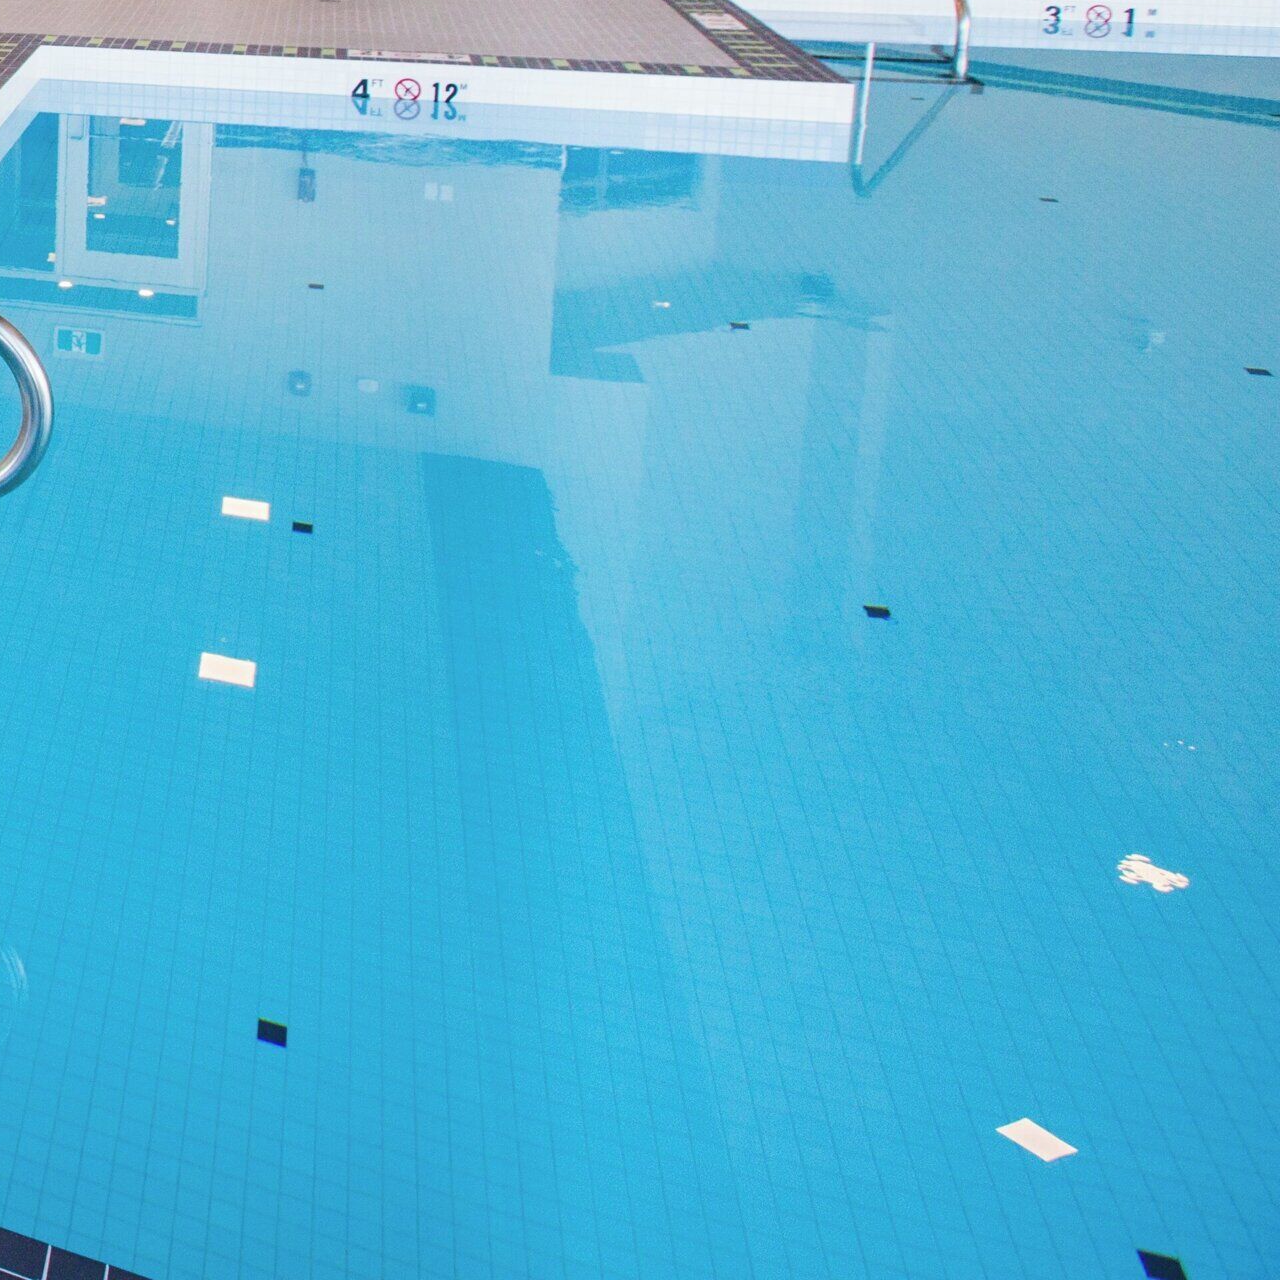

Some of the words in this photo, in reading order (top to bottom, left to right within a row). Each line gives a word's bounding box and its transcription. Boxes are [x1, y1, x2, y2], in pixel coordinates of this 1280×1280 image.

[1044, 6, 1061, 22] 3
[1124, 8, 1135, 24] 1
[352, 79, 370, 98] 4
[372, 79, 384, 87] FT
